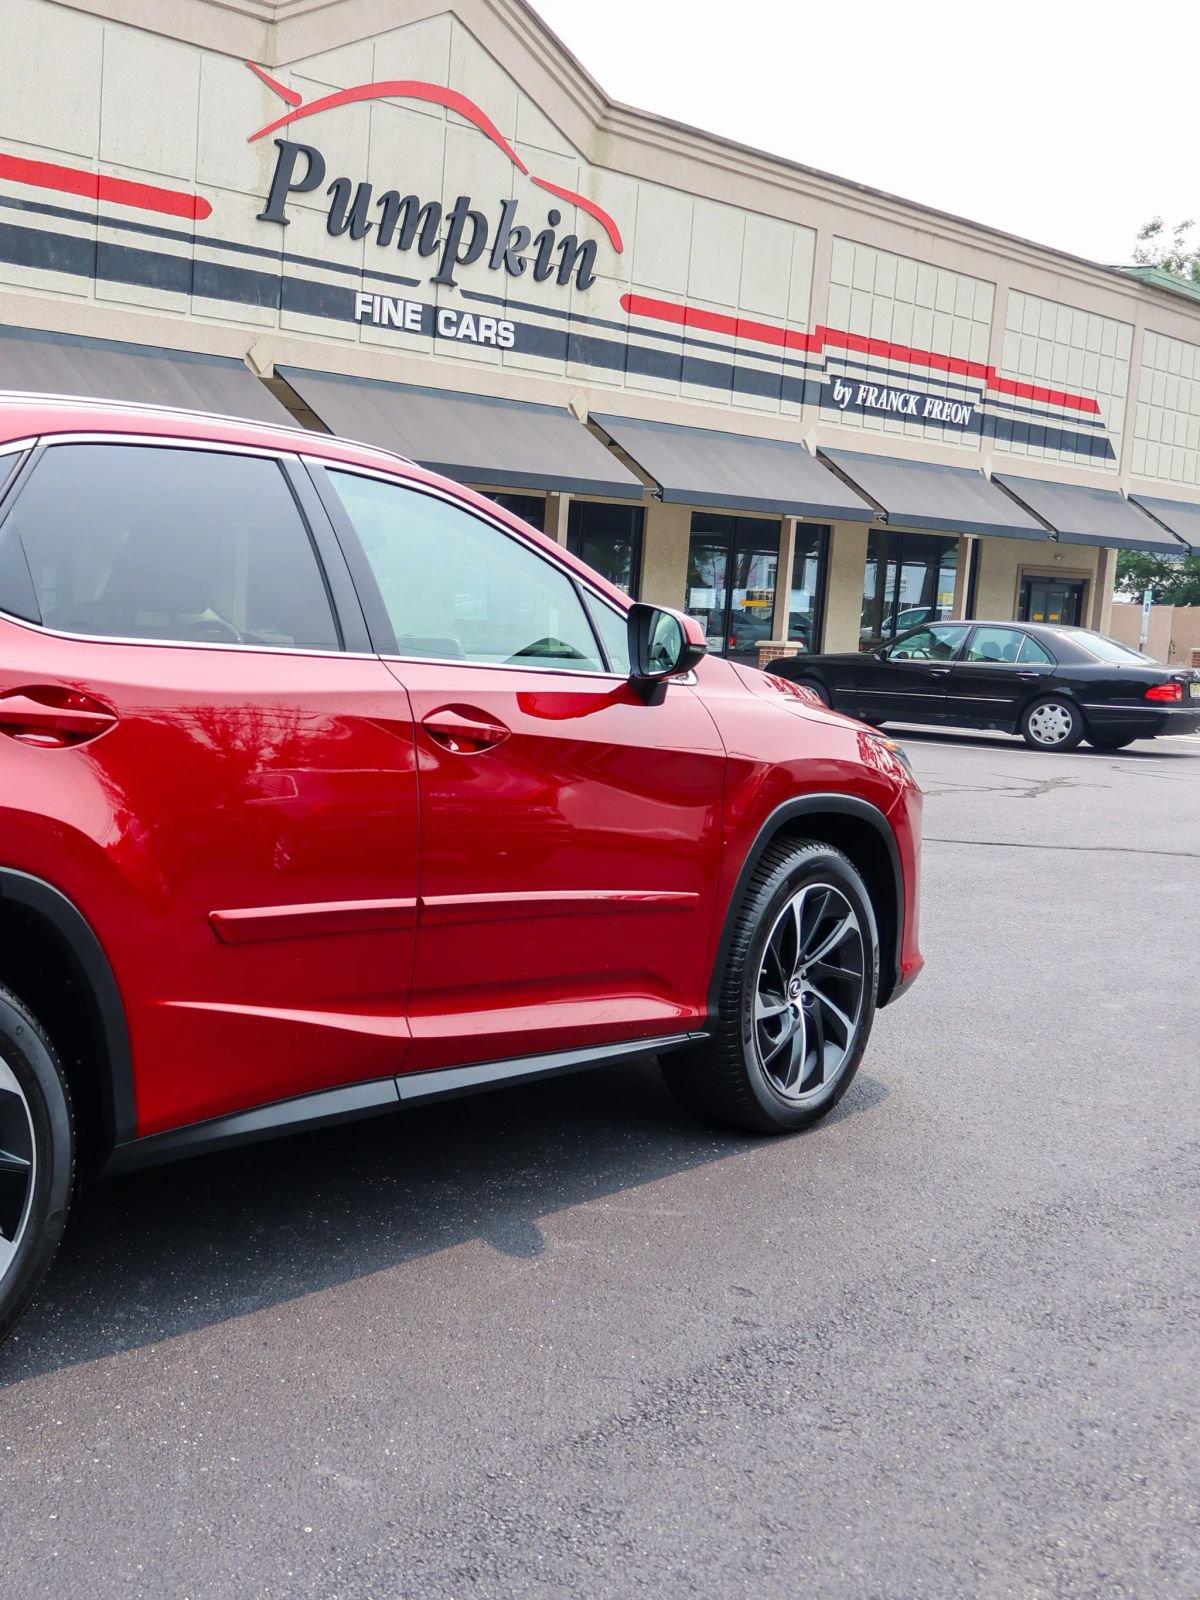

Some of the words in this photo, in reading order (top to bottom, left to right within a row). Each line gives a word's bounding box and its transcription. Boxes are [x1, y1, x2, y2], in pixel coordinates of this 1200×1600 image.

[256, 138, 598, 290] Pumpkin
[353, 291, 423, 332] FINE
[437, 309, 516, 349] CARS
[832, 378, 853, 409] by
[855, 384, 918, 416] FRANCK
[922, 397, 972, 426] FREON
